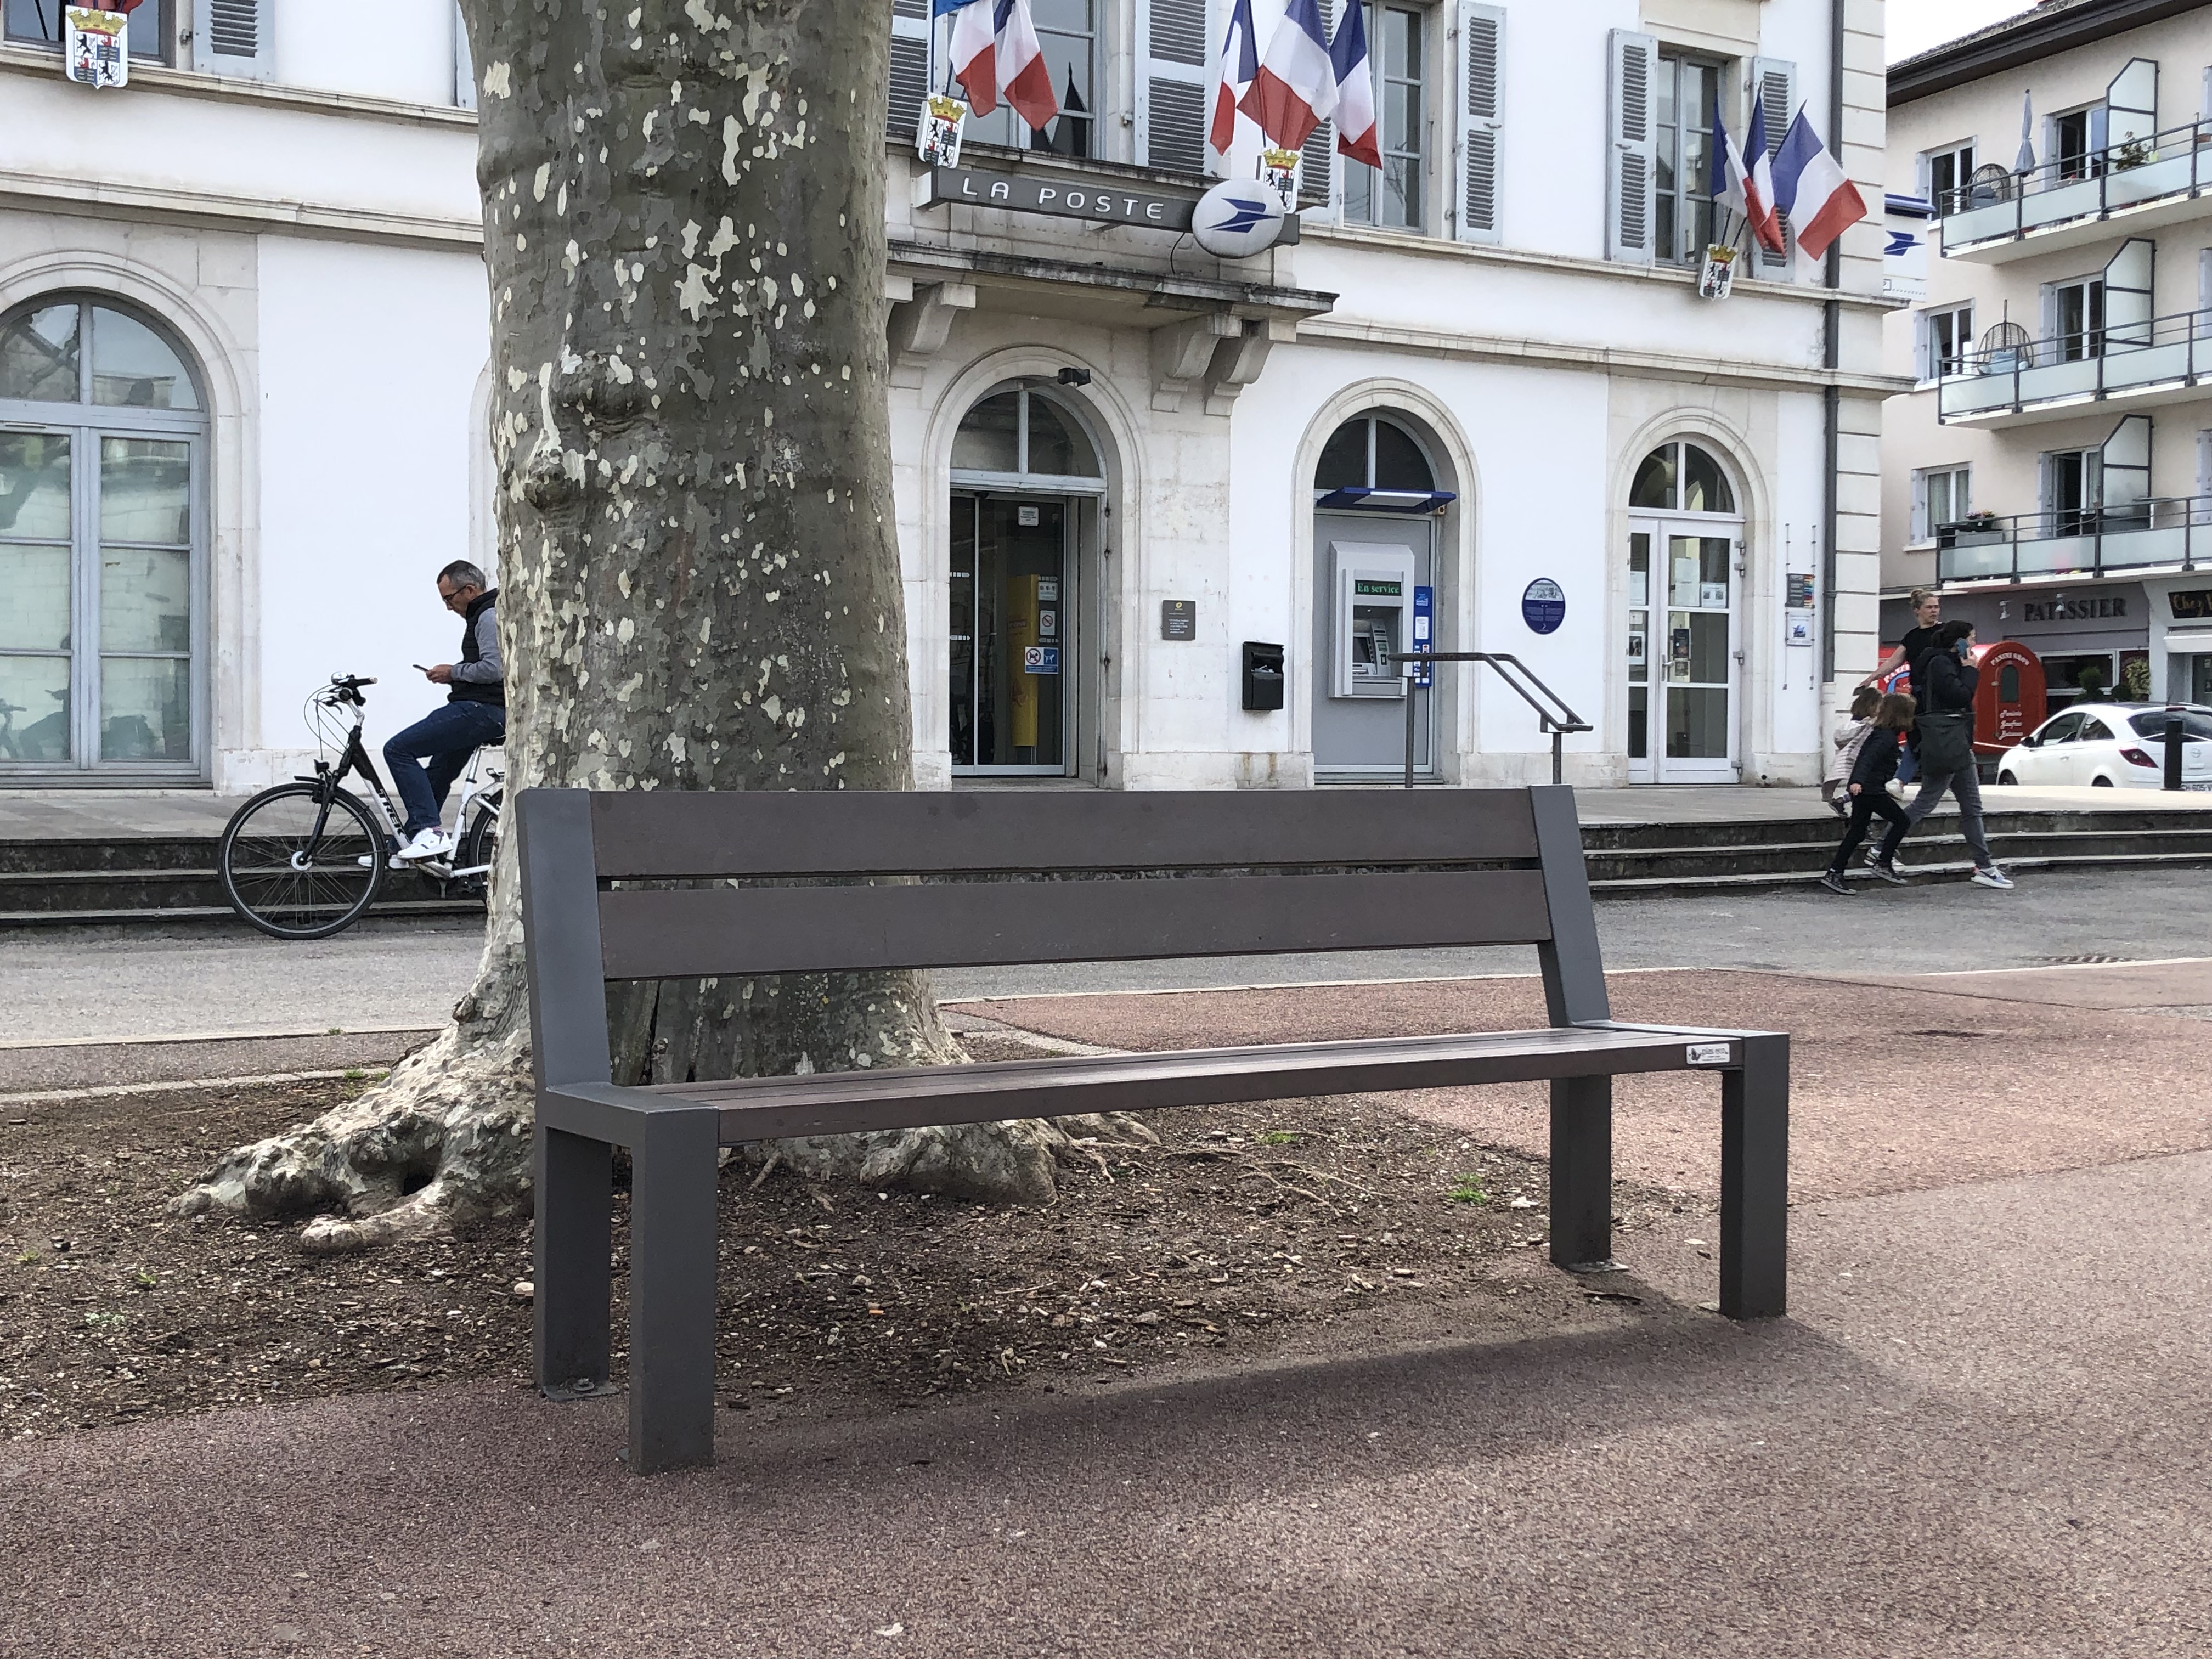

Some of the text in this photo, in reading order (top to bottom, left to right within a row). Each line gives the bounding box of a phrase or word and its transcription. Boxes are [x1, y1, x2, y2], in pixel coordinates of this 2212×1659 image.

[962, 177, 1165, 220] LA POSTE
[1357, 583, 1400, 594] En service
[377, 788, 413, 844] TREK
